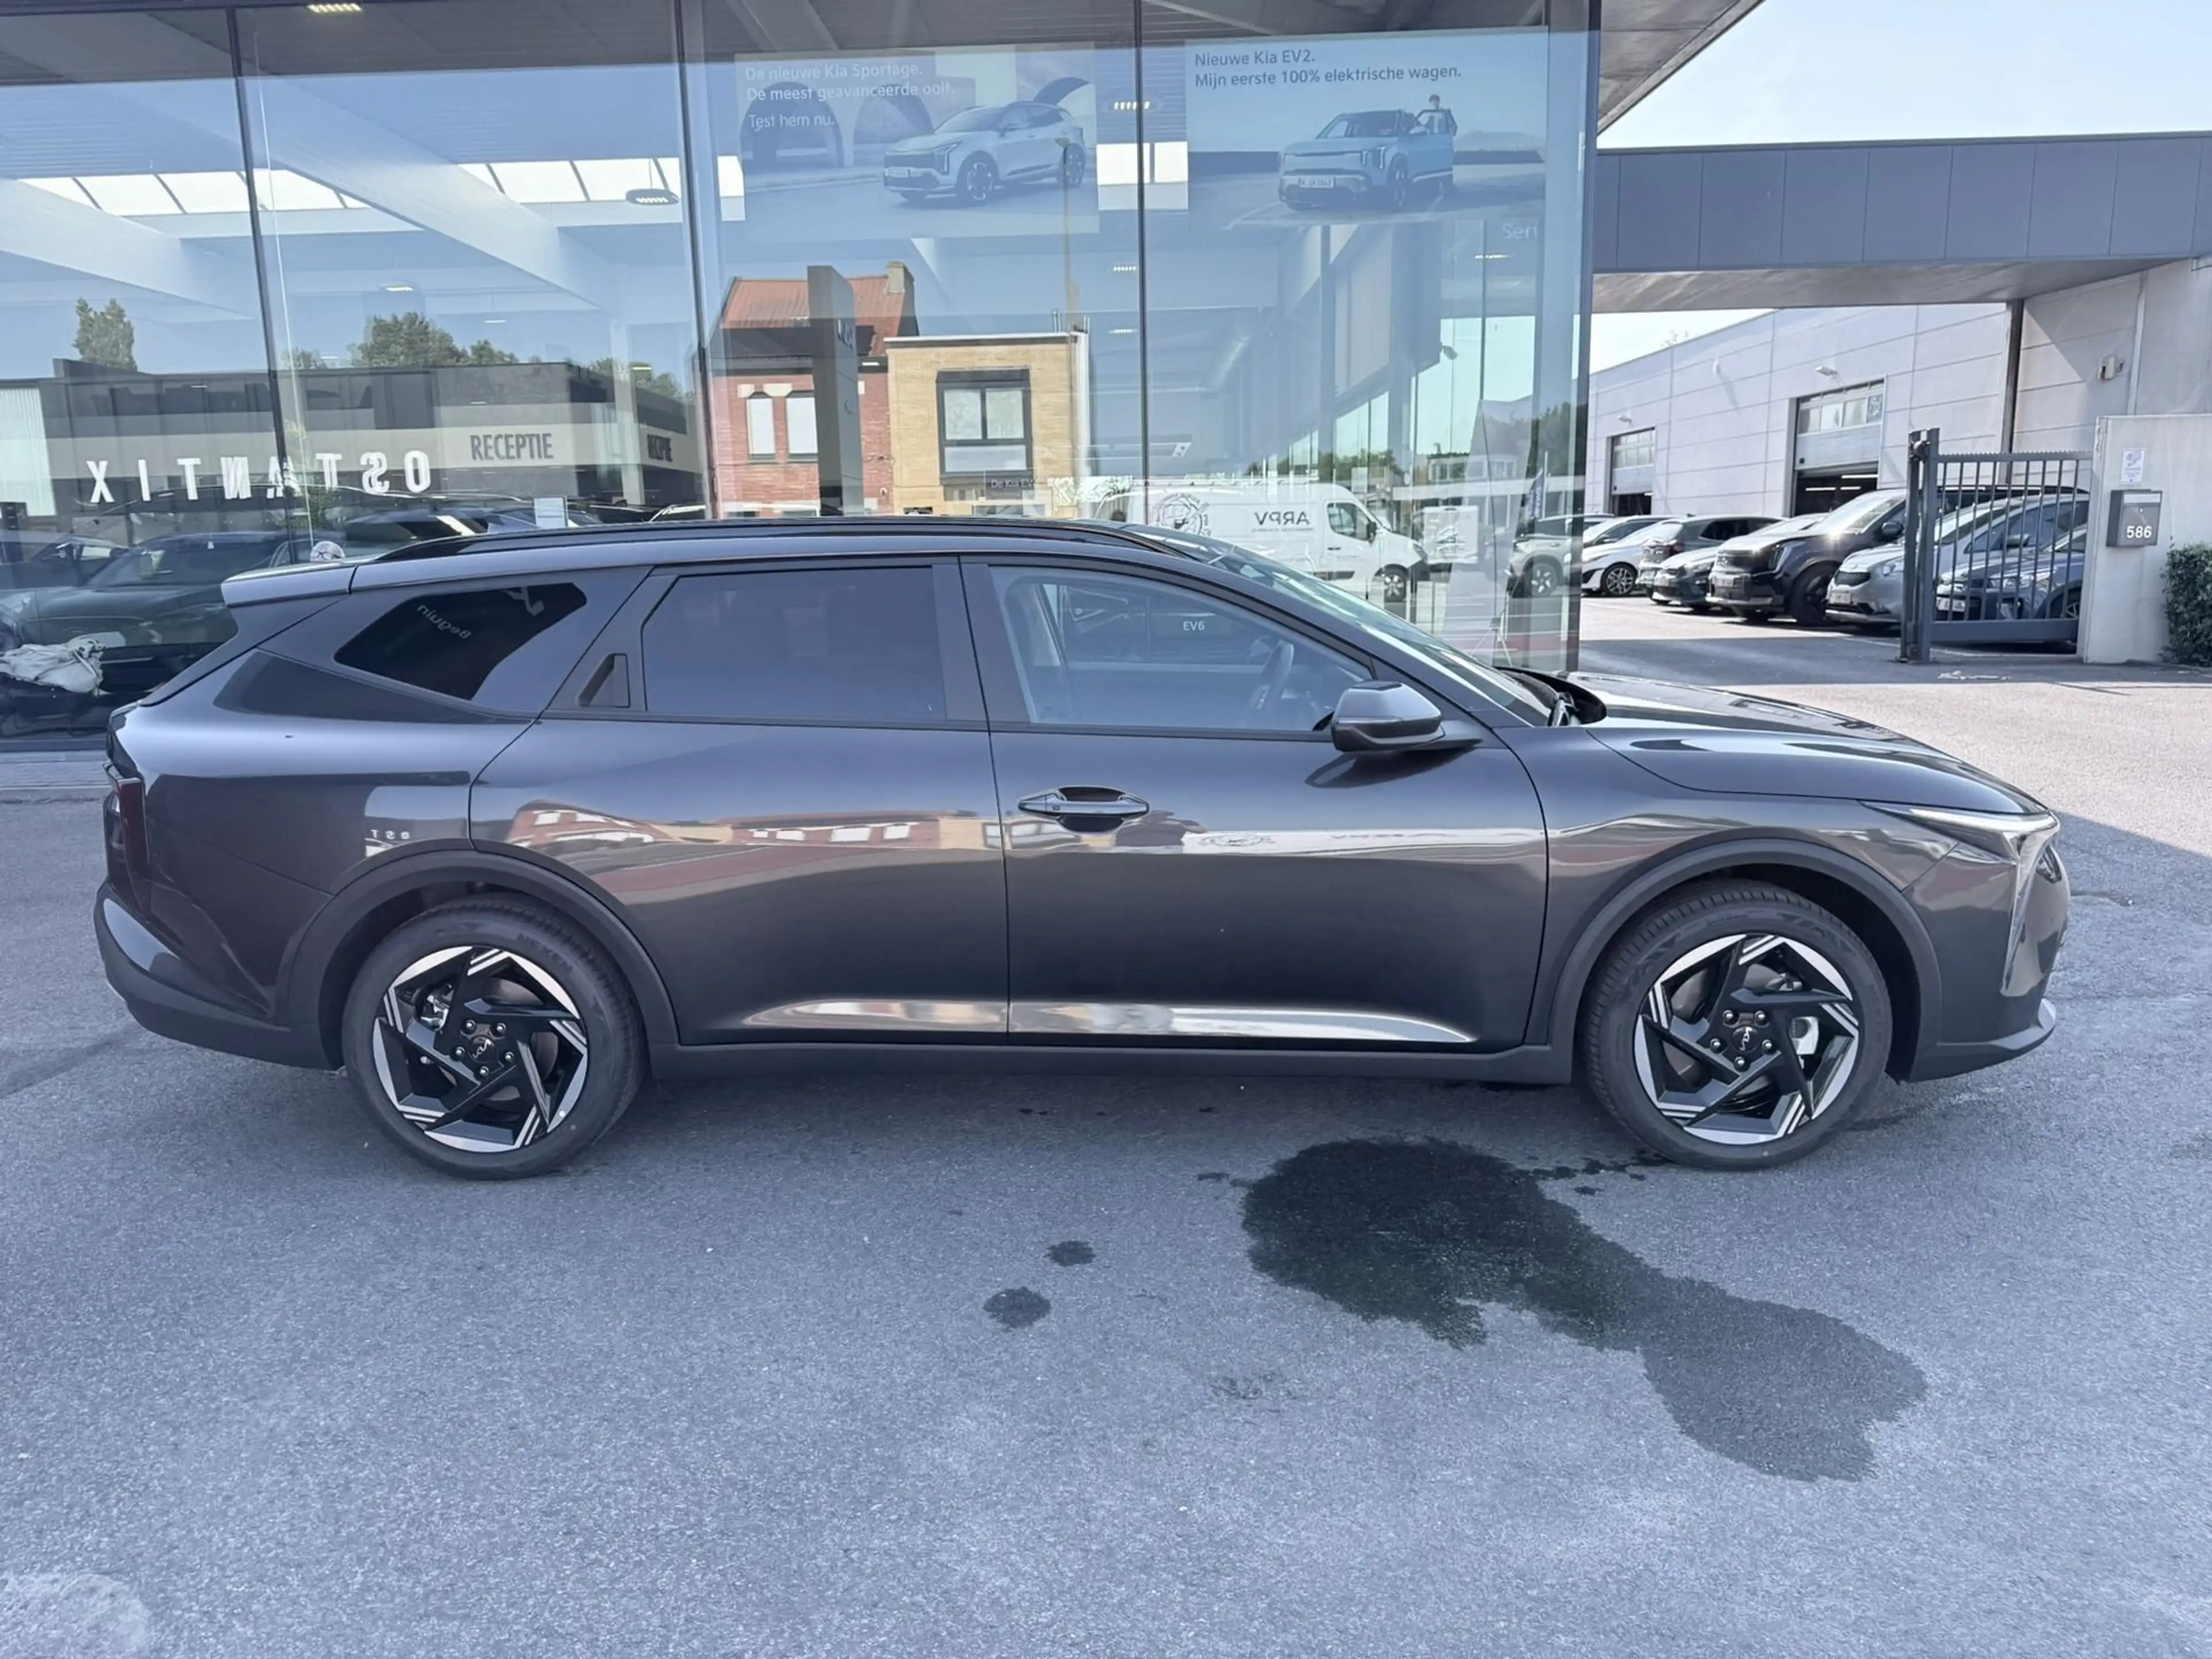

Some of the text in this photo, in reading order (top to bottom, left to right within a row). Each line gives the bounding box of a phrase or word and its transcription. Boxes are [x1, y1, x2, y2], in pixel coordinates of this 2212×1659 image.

[1195, 49, 1316, 66] Nieuwe Kia EV2.
[746, 63, 923, 82] De nieuwe Kia Sportage.
[1195, 66, 1462, 90] Mijn eerste 100% elektrische wagen.
[747, 81, 956, 102] De meest geavanceerde ooit.
[749, 113, 835, 131] Test hem nu.
[469, 433, 554, 461] RECEPTIE
[2126, 525, 2152, 539] 586
[1183, 620, 1205, 632] EV6
